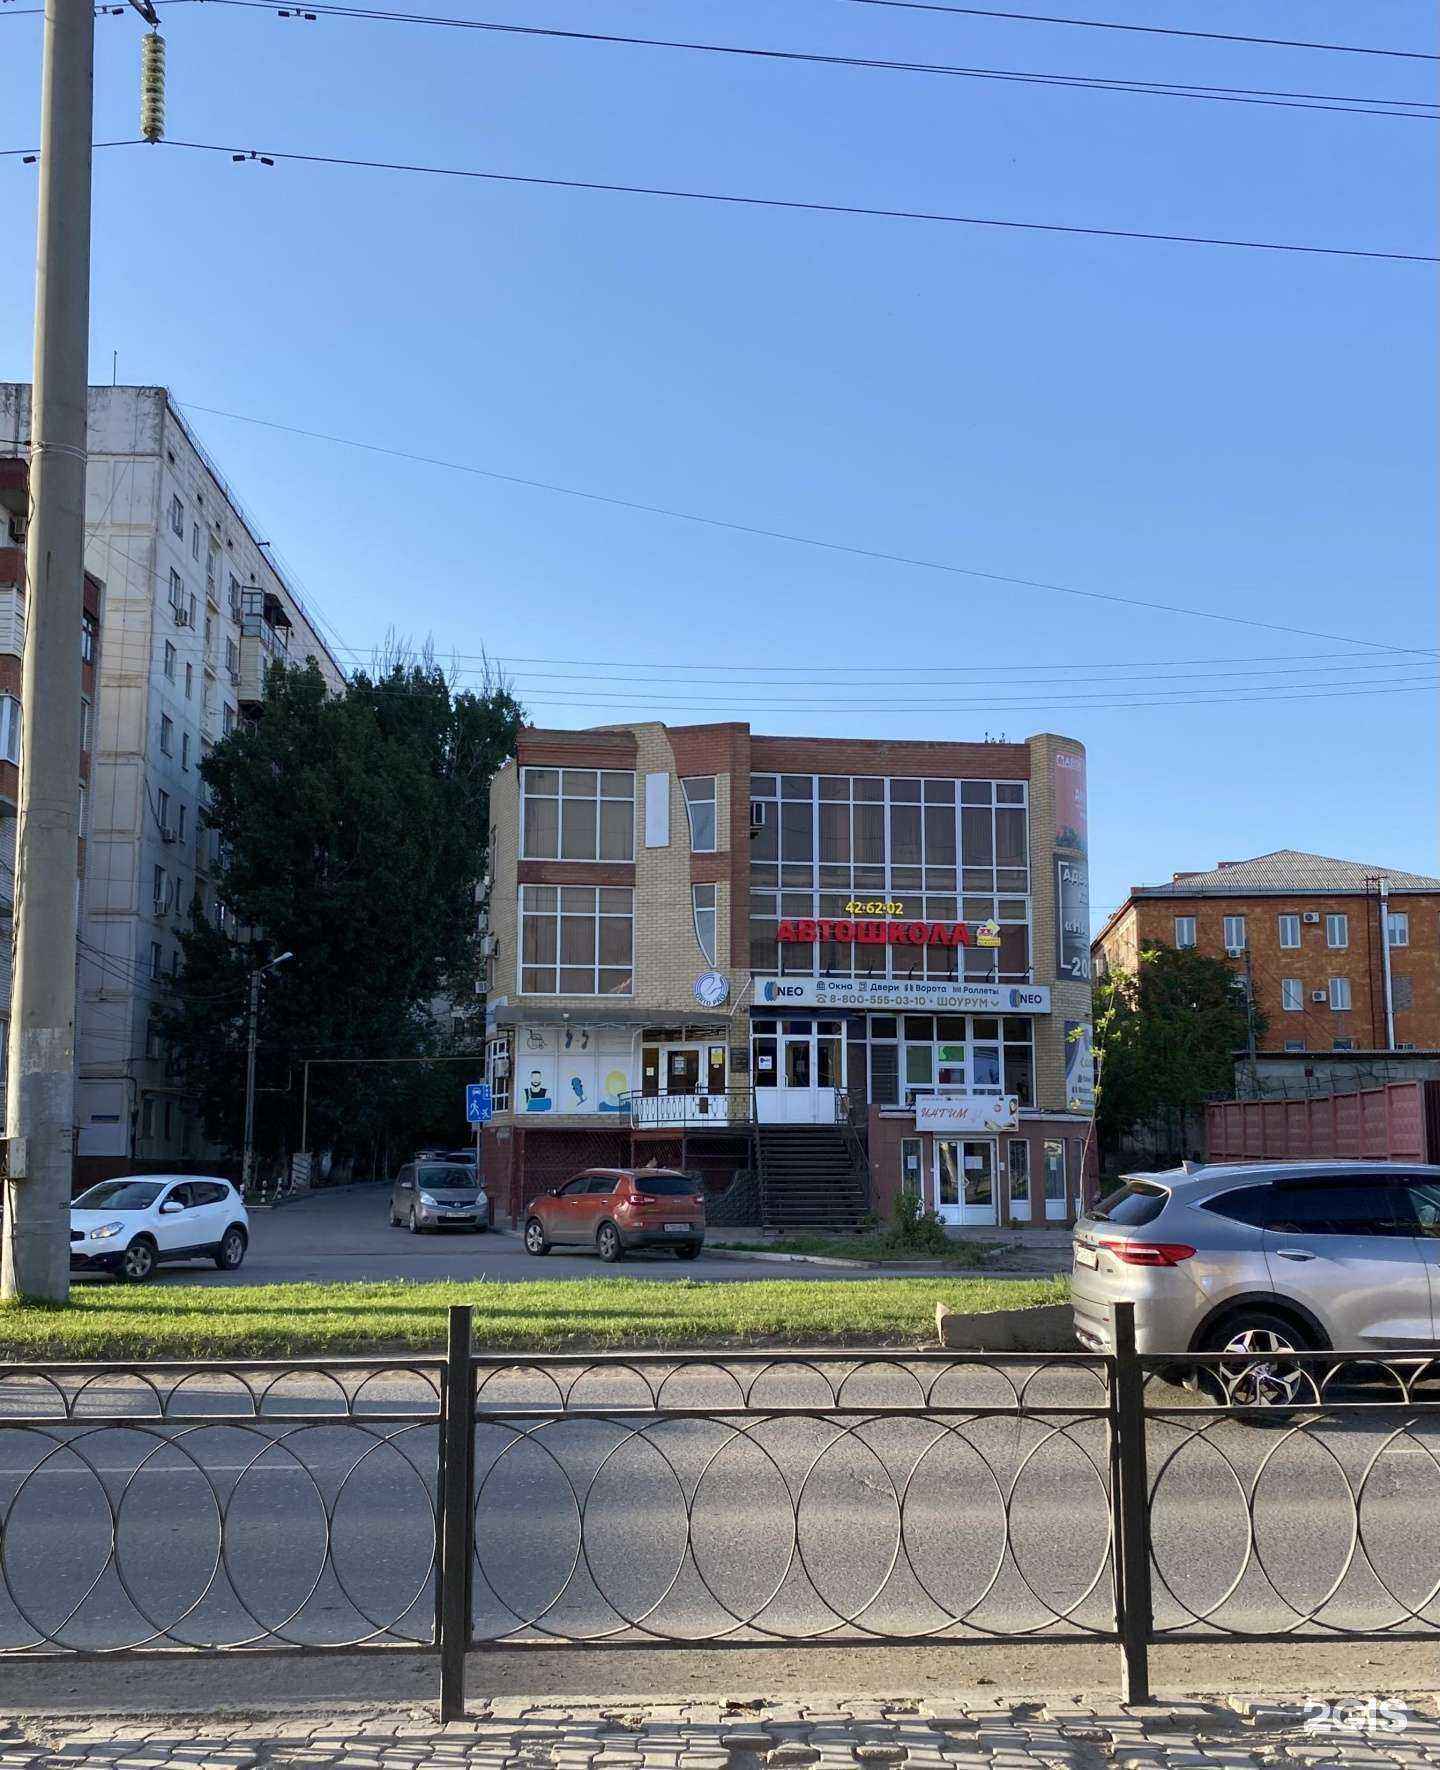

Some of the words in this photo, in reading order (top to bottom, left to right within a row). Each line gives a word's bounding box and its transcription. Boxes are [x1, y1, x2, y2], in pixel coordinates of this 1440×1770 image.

[776, 919, 969, 945] АВТОШКОЛА
[776, 986, 804, 997] NEO
[828, 981, 853, 991] Окна
[870, 982, 900, 993] Двери
[915, 984, 947, 994] Ворота
[963, 986, 999, 996] Роллеты
[829, 994, 927, 1006] 8-800-555-03-10
[936, 997, 989, 1008] ШОУРУМ
[1019, 994, 1042, 1004] NEO
